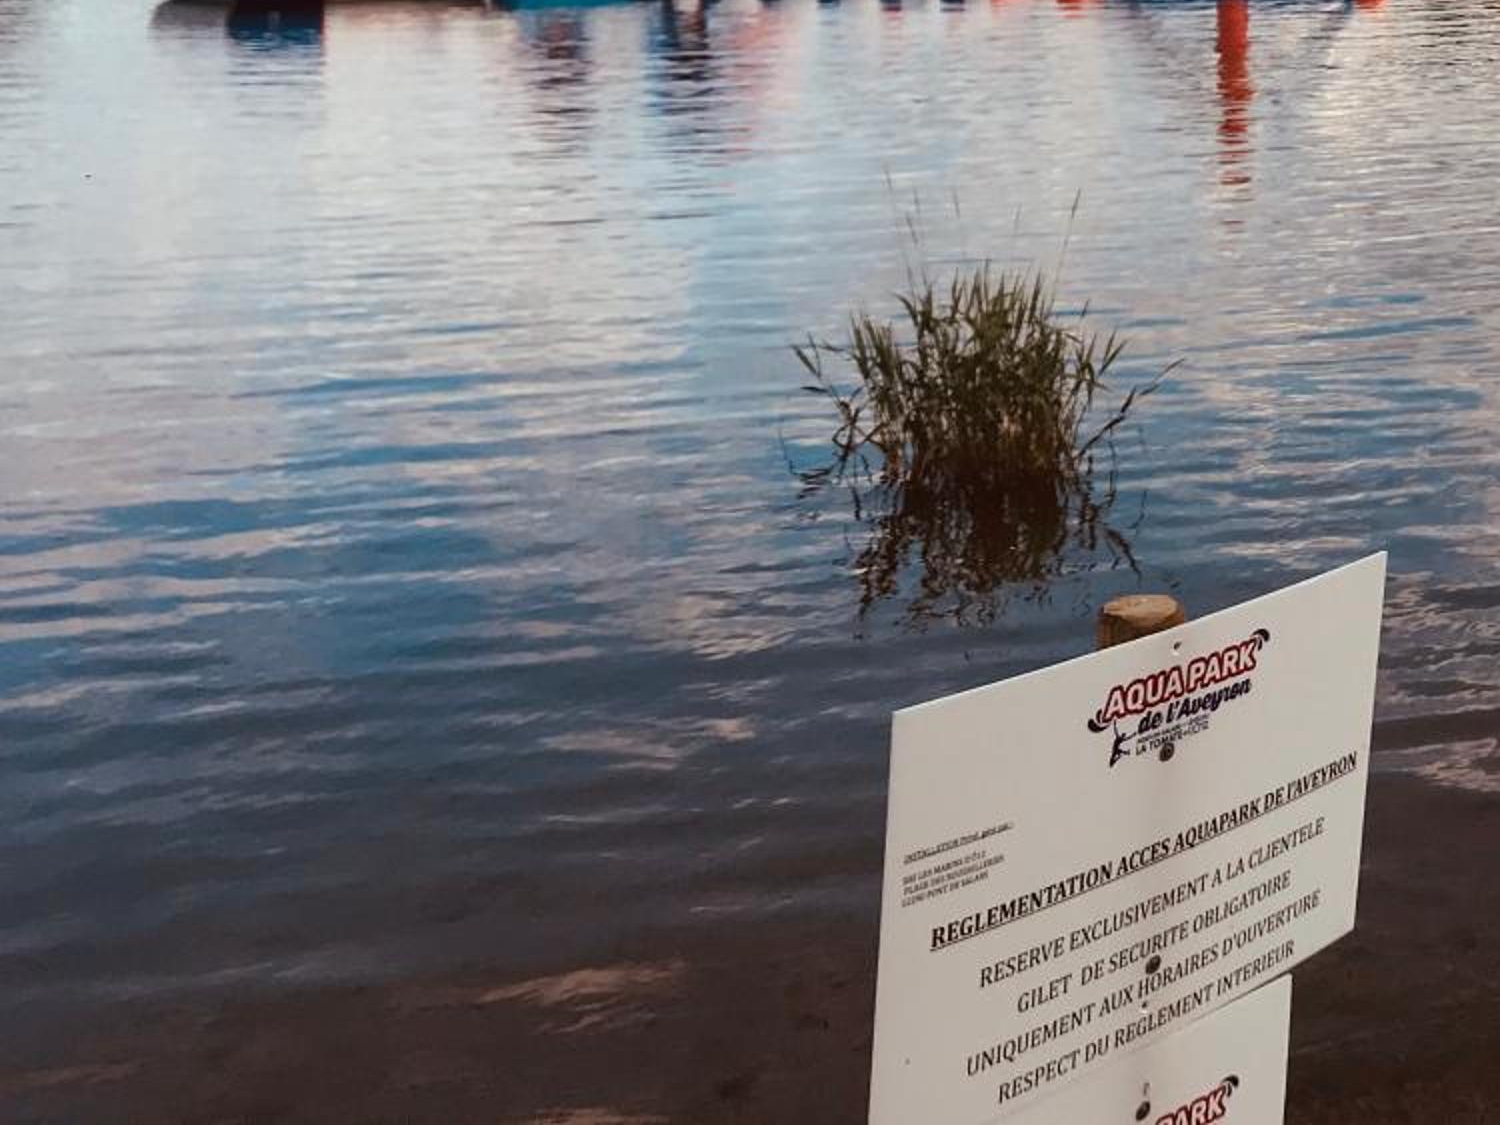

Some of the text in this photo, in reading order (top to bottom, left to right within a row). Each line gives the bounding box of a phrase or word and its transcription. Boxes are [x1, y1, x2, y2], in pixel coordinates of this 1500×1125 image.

[1102, 638, 1257, 723] AQUA PARK
[1138, 711, 1162, 733] de
[1168, 678, 1251, 723] l'Aveyron
[931, 861, 1113, 950] REGLEMENTATION
[1117, 837, 1171, 876] ACCES
[1173, 797, 1261, 852] AQUAPARK
[1264, 786, 1286, 810] DE
[980, 816, 1325, 988] RESERVE EXCLUSIVEMENT A LA CLIENTELE
[1017, 870, 1291, 1014] GILET DE SECURITE OBLIGATOIRE
[966, 889, 1321, 1077] UNIQUEMENT AUX HORAIRES D'OUVERTURE
[998, 939, 1295, 1104] RESPECT DU REGLEMENT INTERIEUR
